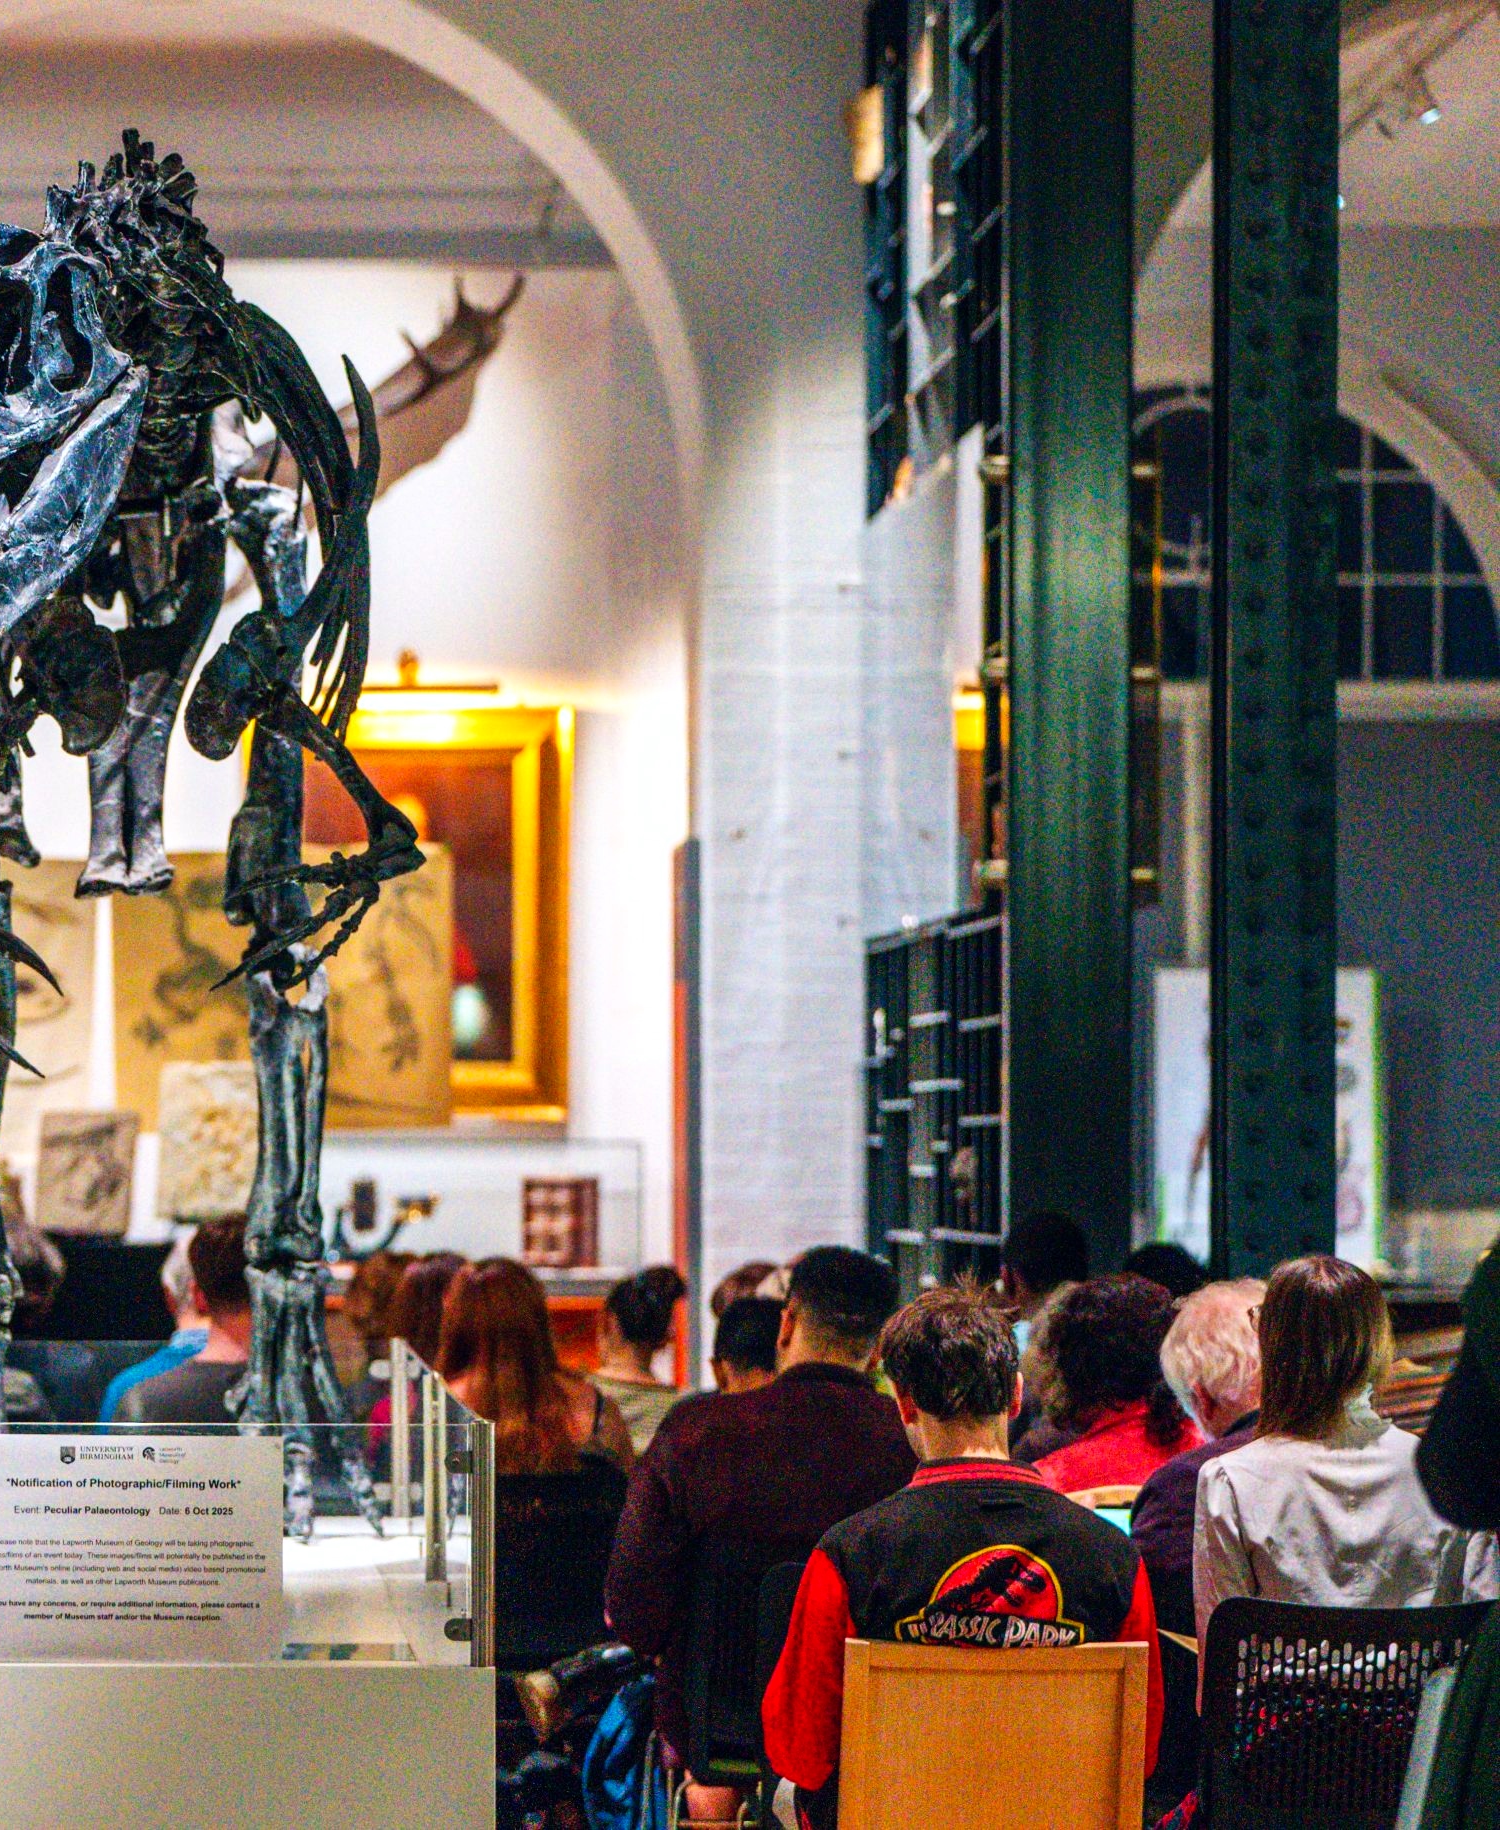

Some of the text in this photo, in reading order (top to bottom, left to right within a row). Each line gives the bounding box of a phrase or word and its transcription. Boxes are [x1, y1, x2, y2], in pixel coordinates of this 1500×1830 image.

[76, 1478, 87, 1488] of
[90, 1479, 206, 1490] Photographic/Filming
[14, 1506, 234, 1516] Event: Peculiar Palaeontology Date: 6 Oct 2025
[62, 1539, 94, 1547] Lapworth
[134, 1539, 163, 1548] Geology
[188, 1539, 208, 1548] taking
[210, 1539, 254, 1548] photographic
[110, 1552, 152, 1561] images/films
[166, 1552, 200, 1561] potentially
[212, 1553, 245, 1562] published
[72, 1565, 104, 1573] (including
[226, 1566, 266, 1575] promotional
[114, 1578, 146, 1587] Lapworth
[90, 1600, 116, 1609] require
[156, 1601, 200, 1609] information,
[201, 1601, 224, 1610] please
[1002, 1615, 1076, 1648] PARK
